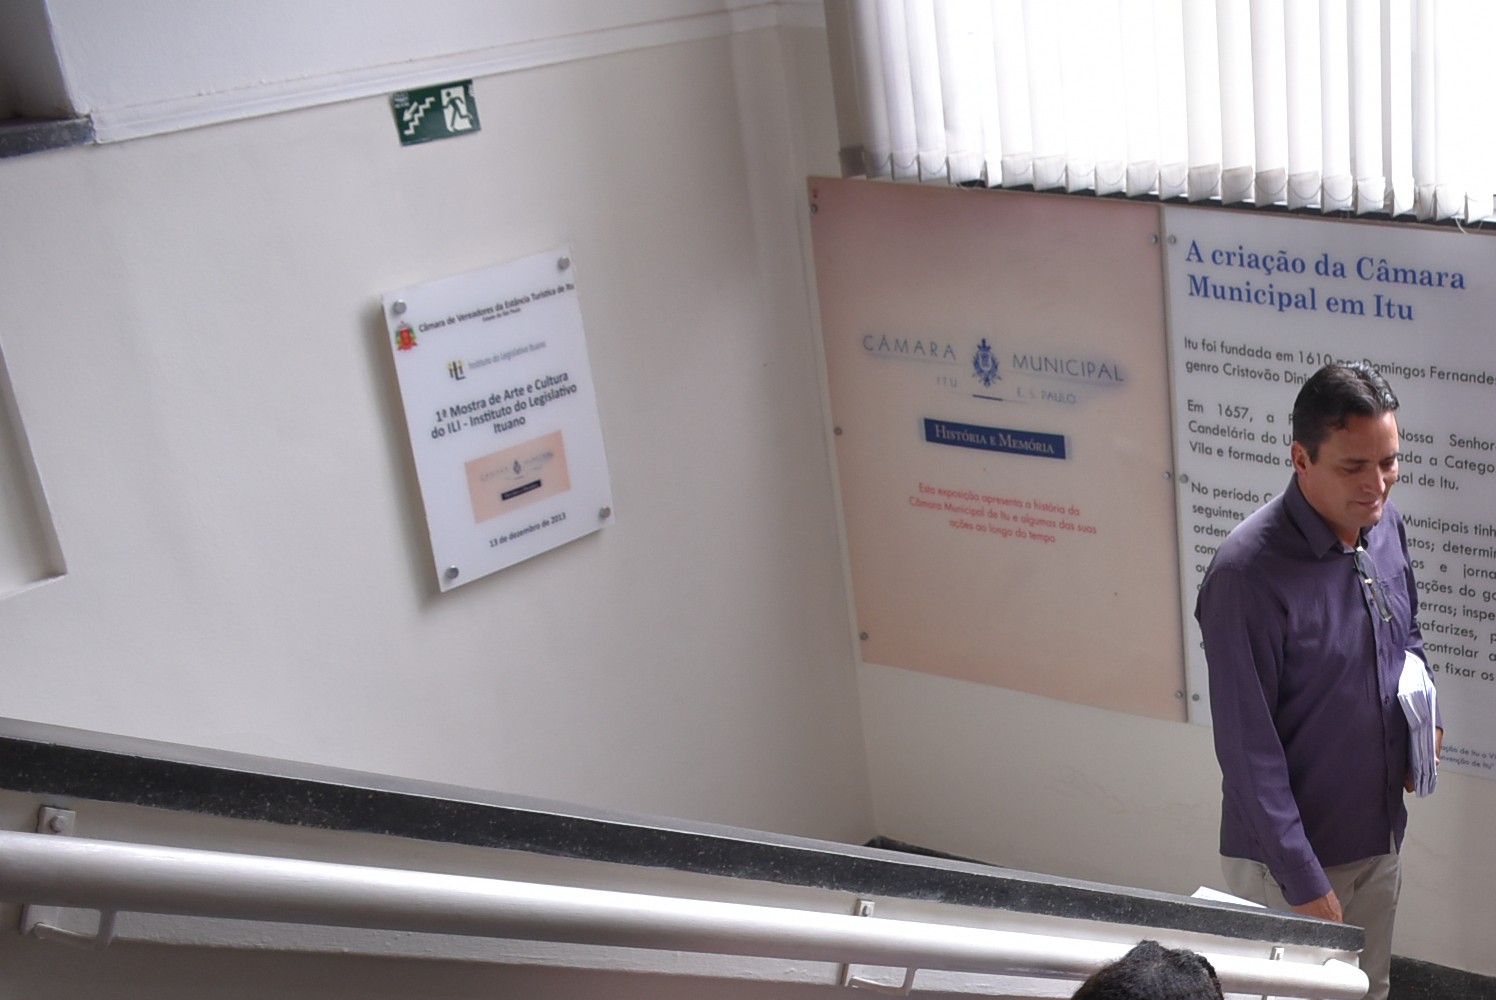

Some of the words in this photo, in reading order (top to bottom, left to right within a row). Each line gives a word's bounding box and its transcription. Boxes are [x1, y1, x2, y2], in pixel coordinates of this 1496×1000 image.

[1185, 240, 1203, 263] A
[1211, 245, 1306, 276] criação
[1314, 253, 1347, 277] da
[1356, 255, 1466, 289] Câmara
[1187, 274, 1317, 312] Municipal
[1325, 296, 1365, 314] em
[1372, 295, 1414, 320] Itu
[862, 334, 957, 361] CÂMARA
[1012, 353, 1125, 382] MUNICIPAL
[1184, 337, 1198, 350] Itu
[1201, 339, 1217, 352] foi
[1220, 341, 1272, 359] fundada
[1276, 352, 1294, 362] em
[1299, 351, 1333, 366] 1610
[937, 376, 958, 388] ITU
[1185, 361, 1219, 373] genro
[1223, 363, 1280, 381] Cristovão
[1284, 371, 1310, 385] Dini
[435, 409, 447, 423] 1ª
[450, 400, 487, 418] Mostra
[488, 394, 502, 406] de
[503, 386, 525, 401] Arte
[526, 385, 533, 394] e
[535, 374, 569, 391] Cultura
[1040, 390, 1077, 405] PAULO
[431, 427, 446, 439] do
[447, 419, 461, 434] ILI
[470, 405, 512, 427] Instituto
[514, 400, 527, 412] do
[528, 384, 577, 407] Legislativo
[1187, 400, 1204, 414] Em
[1218, 404, 1253, 423] 1657,
[1266, 414, 1274, 423] a
[1398, 429, 1434, 444] Nossa
[493, 417, 526, 434] Ituano
[1188, 420, 1255, 441] Candelária
[1261, 431, 1277, 444] do
[1429, 457, 1438, 465] a
[1189, 440, 1213, 455] Vila
[1216, 448, 1224, 457] e
[1228, 446, 1280, 465] formada
[1418, 474, 1435, 487] de
[1440, 476, 1460, 490] Itu.
[919, 483, 935, 495] Esta
[937, 488, 980, 502] exposição
[982, 495, 1023, 508] apresenta
[1025, 501, 1031, 509] a
[1033, 500, 1065, 514] história
[1068, 505, 1080, 516] da
[1191, 481, 1208, 495] No
[1213, 488, 1259, 503] período
[909, 496, 942, 510] Câmara
[944, 501, 985, 518] Municipal
[986, 508, 998, 519] de
[1000, 510, 1010, 521] Itu
[1012, 514, 1018, 522] e
[1020, 514, 1056, 528] algumas
[1058, 519, 1075, 531] das
[1077, 525, 1097, 534] suas
[1192, 505, 1245, 521] seguintes
[1402, 514, 1469, 534] Municipais
[489, 537, 498, 548] 13
[499, 535, 508, 544] de
[509, 523, 540, 541] dezembro
[541, 519, 550, 528] de
[551, 511, 567, 525] 2013
[949, 520, 973, 531] ações
[975, 524, 987, 532] ao
[988, 523, 1013, 538] longo
[1028, 529, 1056, 544] tempo
[1440, 564, 1448, 573] e
[1459, 584, 1476, 597] do
[1418, 600, 1457, 617] erras;
[1422, 643, 1479, 659] controlar
[1488, 653, 1496, 662] a
[1432, 664, 1440, 673] e
[1445, 663, 1476, 678] fixar
[1480, 672, 1495, 681] os
